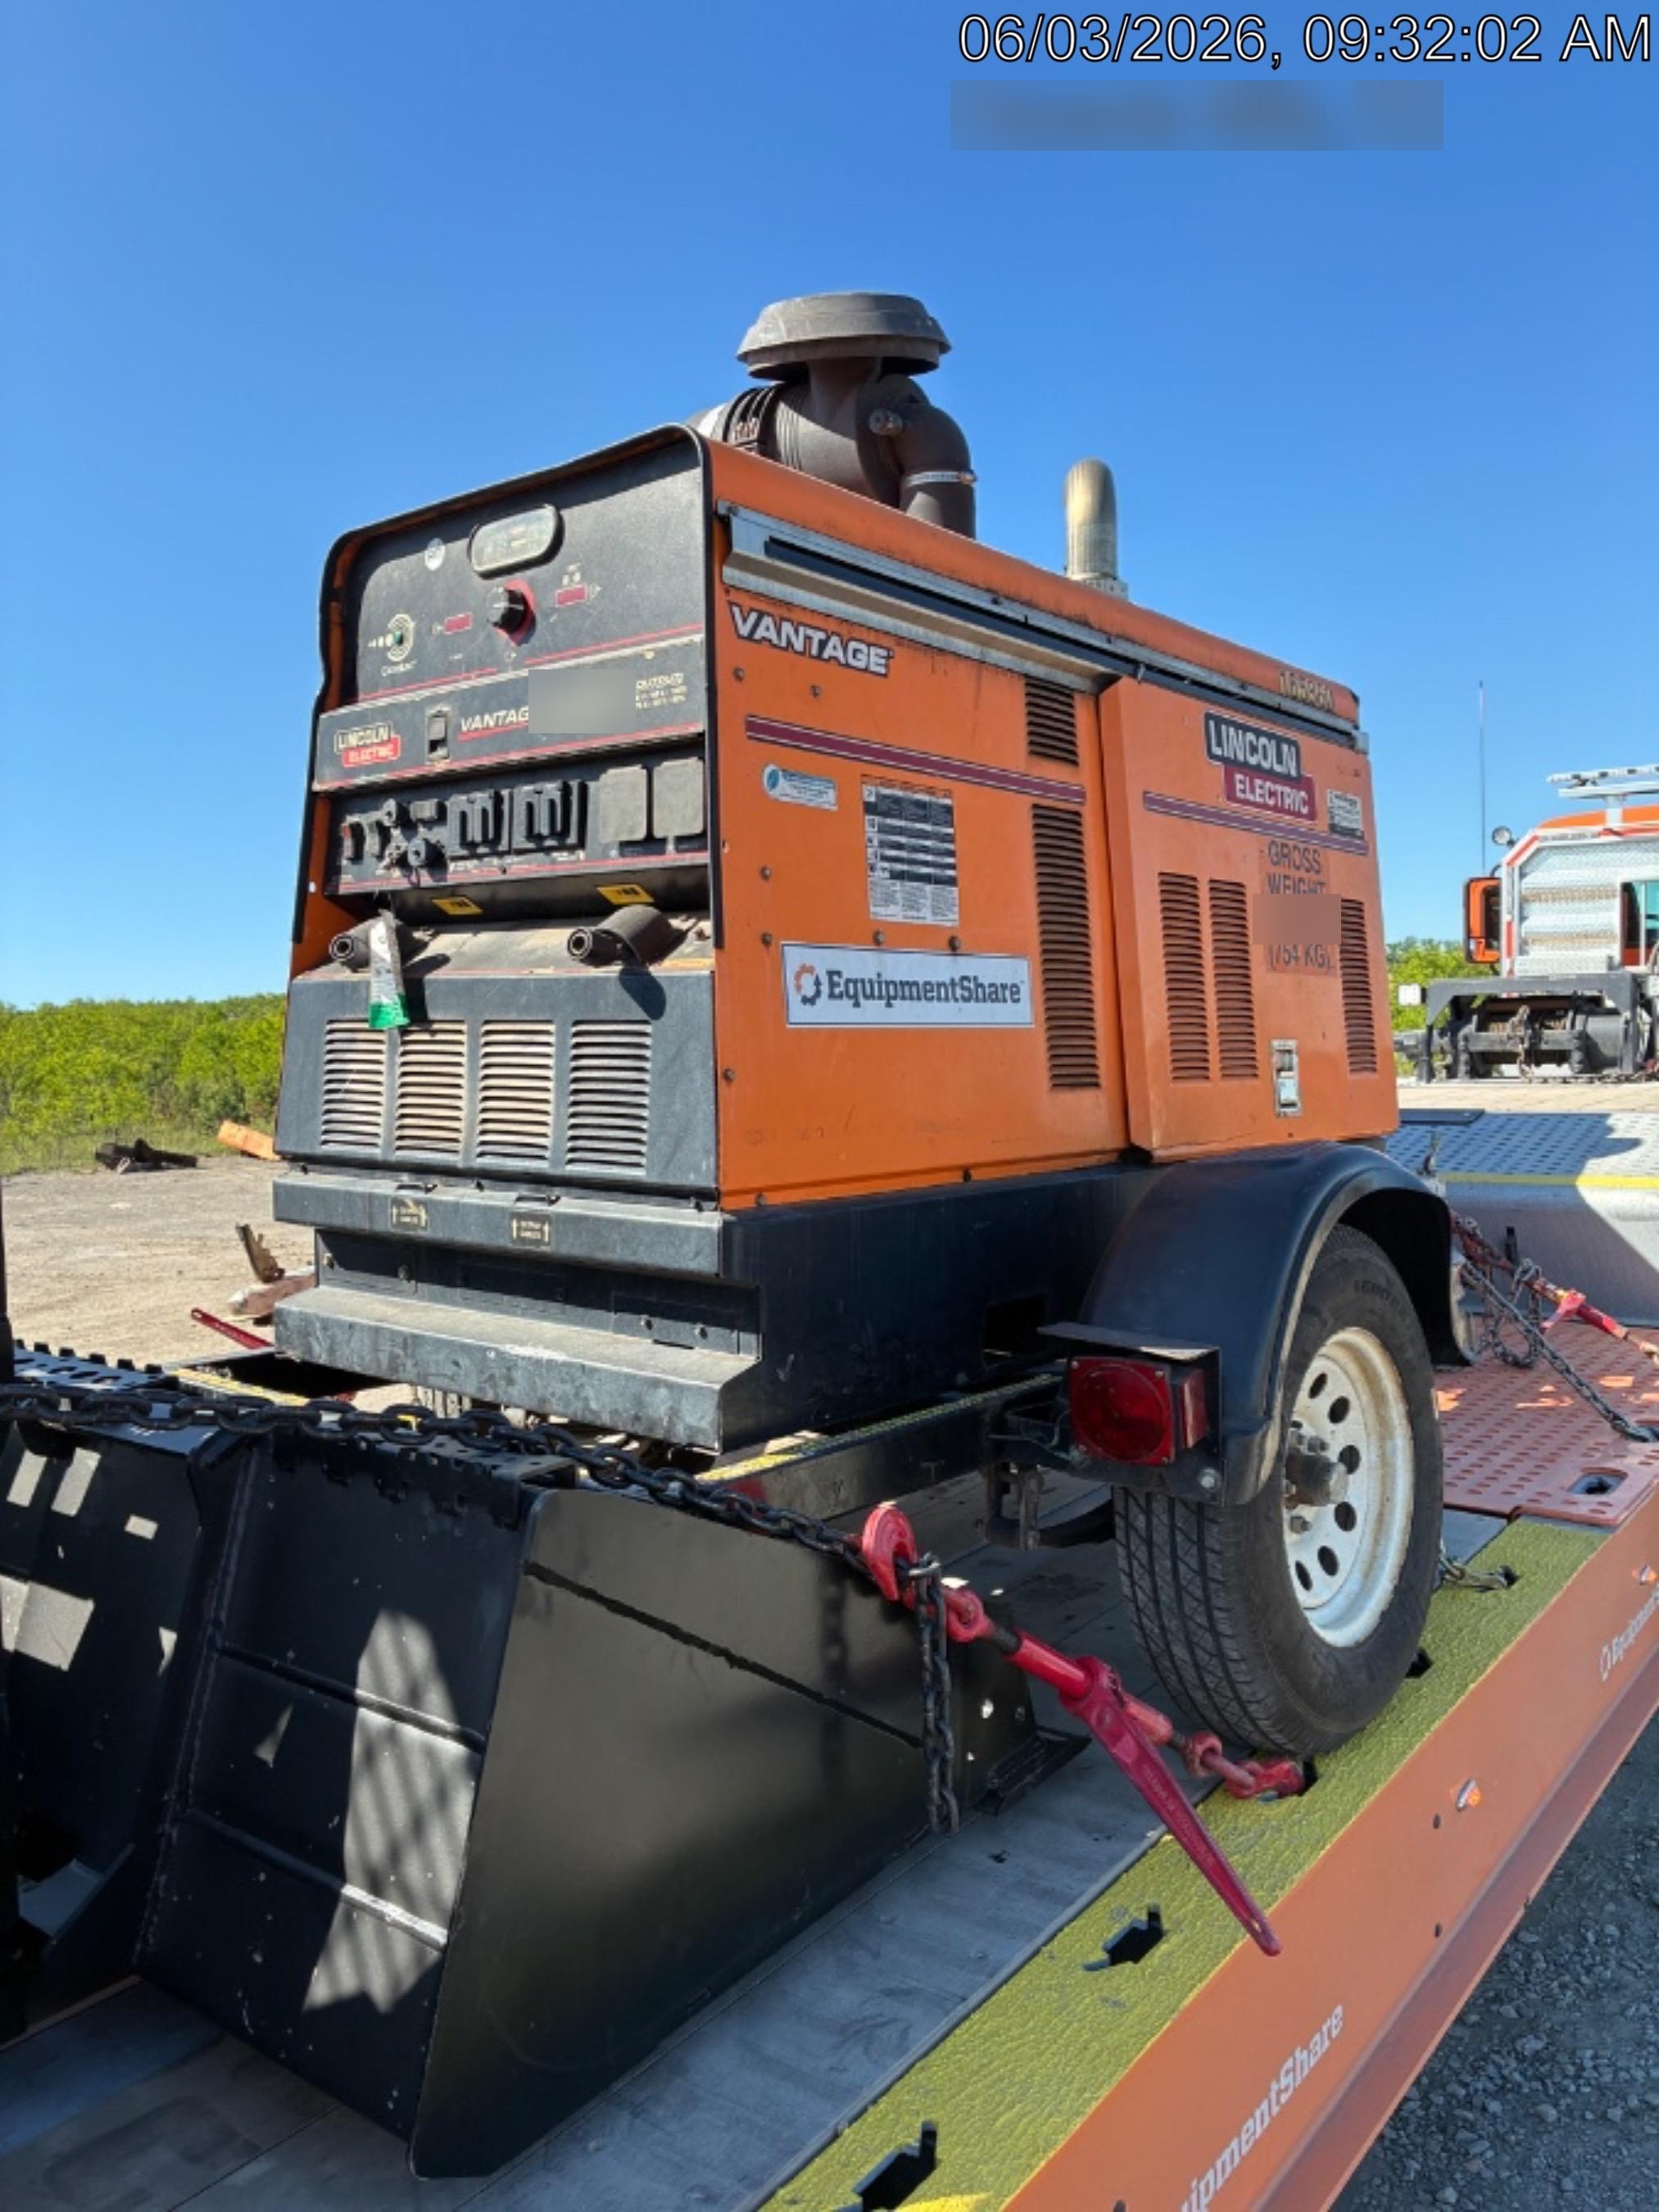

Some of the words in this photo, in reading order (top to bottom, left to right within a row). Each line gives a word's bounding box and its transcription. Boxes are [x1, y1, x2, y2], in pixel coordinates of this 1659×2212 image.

[730, 605, 889, 675] VANTAGE
[461, 705, 528, 732] VANTAG
[1208, 719, 1297, 777] LINCOLN
[1234, 773, 1309, 814] ELECTRIC
[1268, 840, 1322, 875] GROSS
[826, 969, 1022, 1008] EquipmentShare
[1181, 2005, 1344, 2212] ipmentShare
